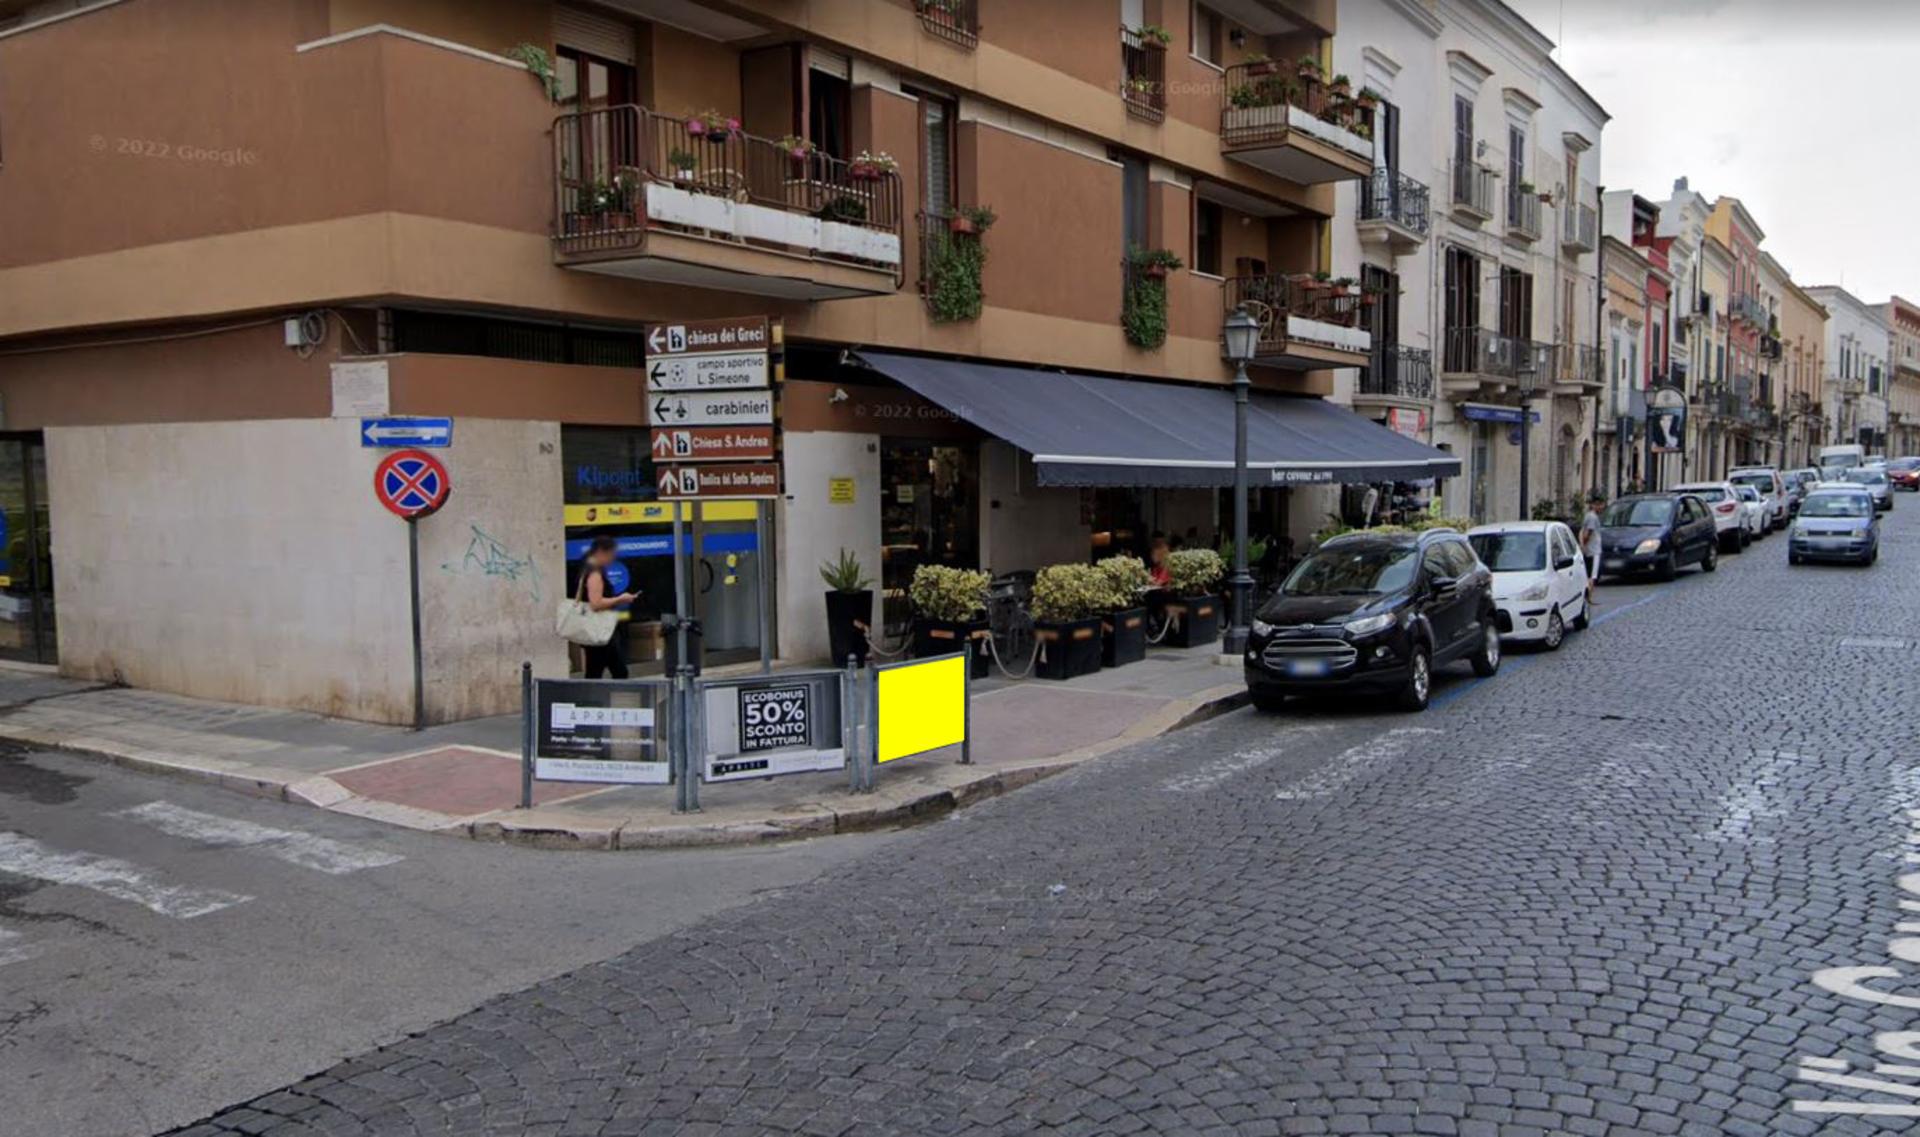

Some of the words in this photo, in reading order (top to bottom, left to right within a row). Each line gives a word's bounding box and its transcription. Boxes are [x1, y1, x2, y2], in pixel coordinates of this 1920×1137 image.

[687, 328, 718, 345] chiesa
[721, 327, 735, 344] dei
[738, 325, 764, 342] Greci
[697, 361, 725, 371] campo
[728, 357, 764, 370] sportivo
[708, 373, 751, 386] Simeone
[706, 399, 769, 416] carabinieri
[692, 435, 723, 449] Chiesa
[735, 434, 769, 448] Andrea
[745, 689, 804, 704] ECOBONUS
[569, 710, 639, 722] APRITI
[746, 699, 805, 725] 50%
[746, 722, 805, 738] SCONTO
[746, 738, 758, 749] IN
[758, 735, 805, 748] FATTURA
